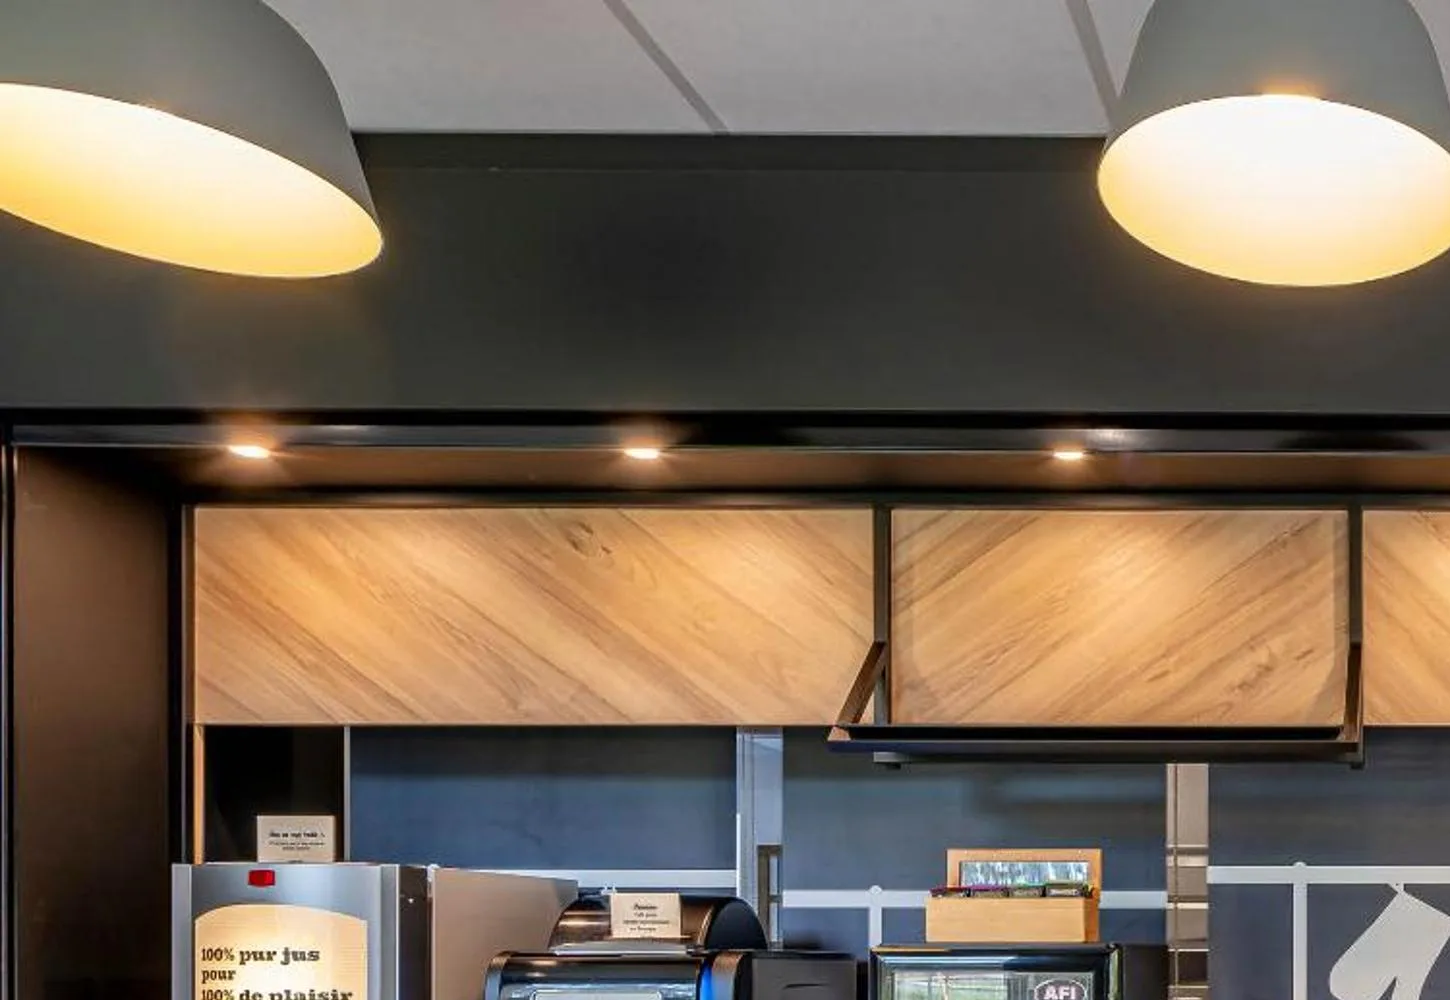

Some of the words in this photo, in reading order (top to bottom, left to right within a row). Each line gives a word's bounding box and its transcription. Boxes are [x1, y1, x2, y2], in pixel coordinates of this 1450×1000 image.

[201, 948, 235, 962] 100%
[239, 949, 277, 965] pur
[281, 947, 320, 965] jus
[201, 969, 236, 984] pour
[1044, 985, 1076, 1000] AFI
